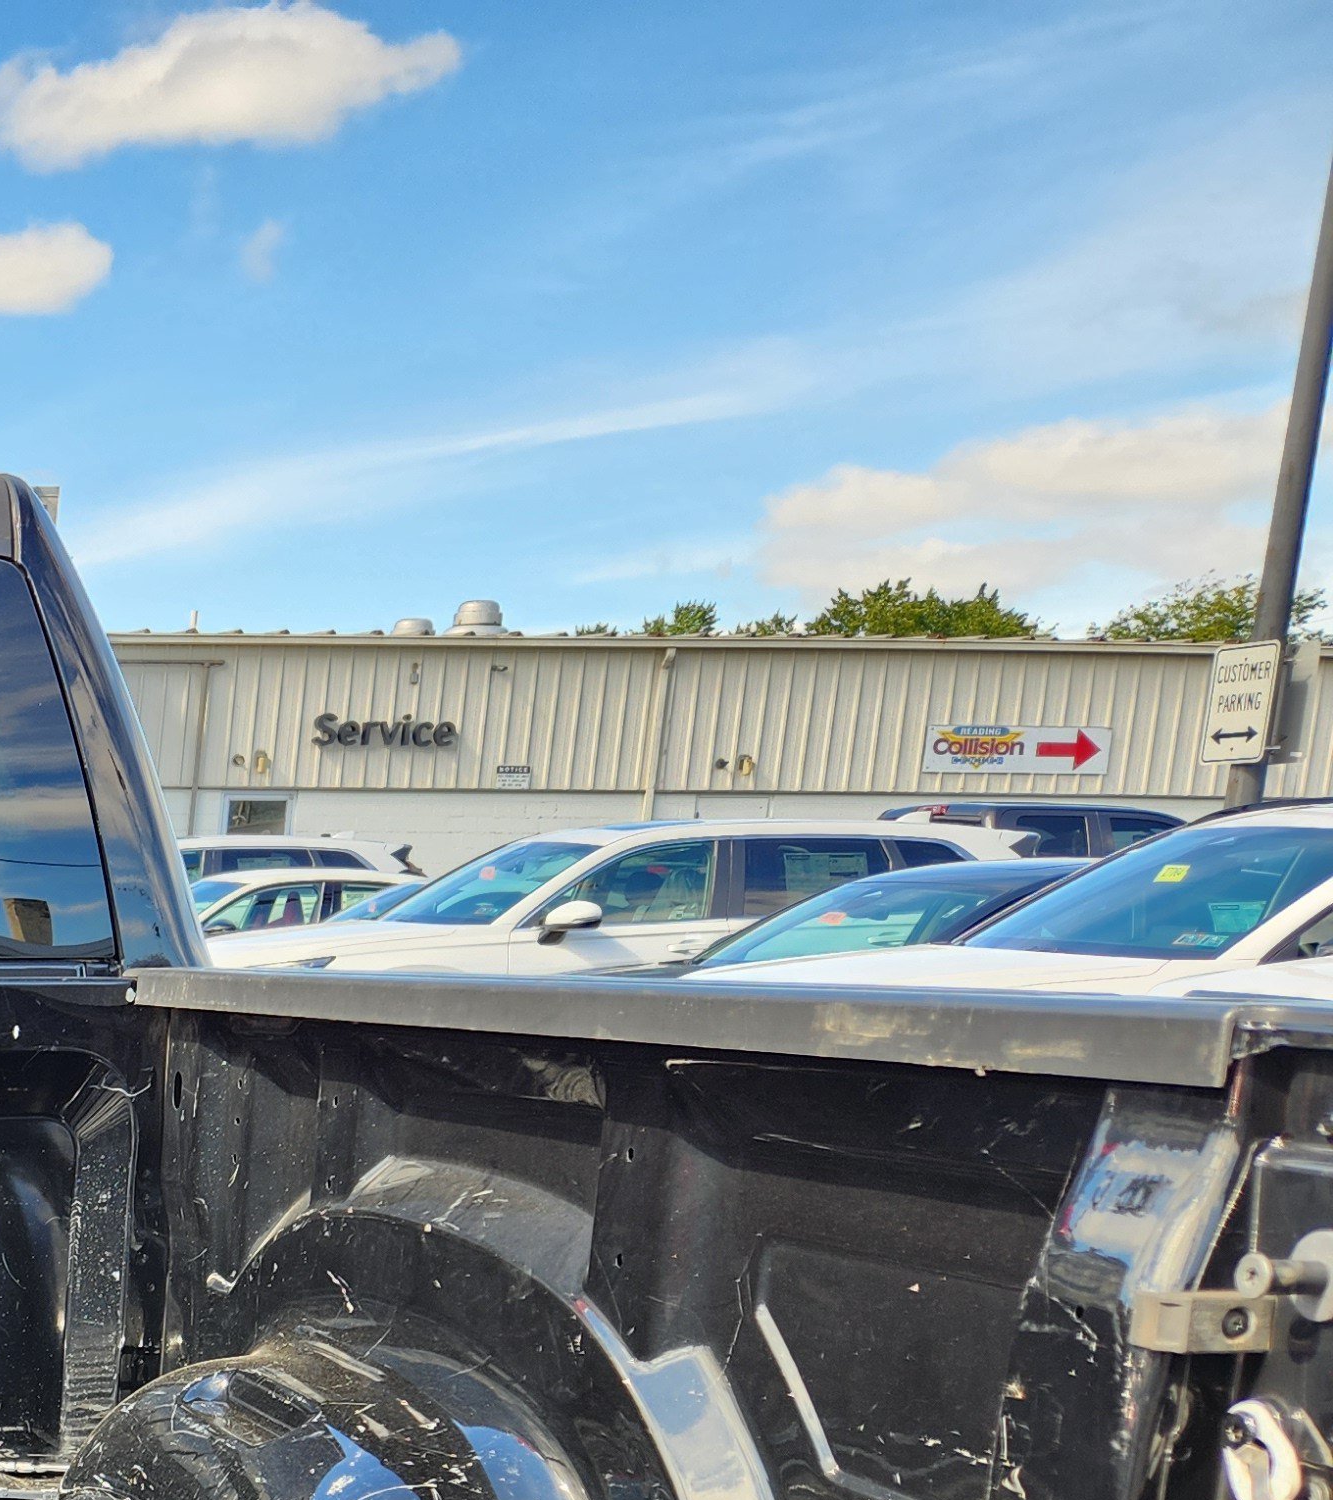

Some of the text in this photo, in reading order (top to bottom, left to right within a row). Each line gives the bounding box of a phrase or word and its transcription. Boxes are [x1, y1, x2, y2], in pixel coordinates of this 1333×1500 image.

[1217, 660, 1272, 684] CUSTOMER
[1217, 691, 1263, 713] PARKING
[311, 712, 458, 748] Service
[932, 737, 1025, 755] Collision
